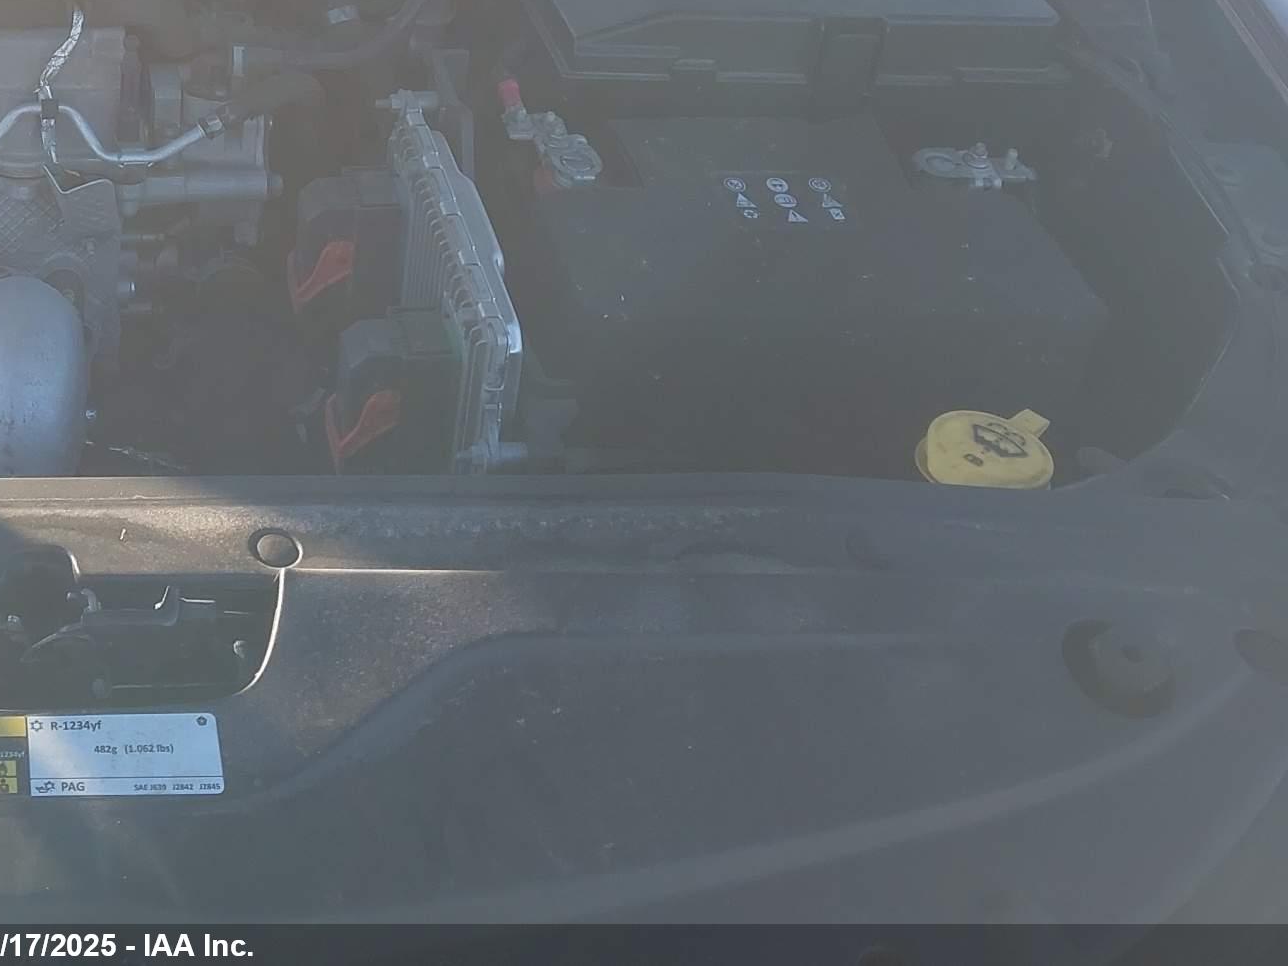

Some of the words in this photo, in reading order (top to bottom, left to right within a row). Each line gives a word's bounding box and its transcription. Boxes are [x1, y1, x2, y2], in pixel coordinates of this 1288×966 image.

[50, 719, 102, 732] R-1234yf
[94, 744, 118, 755] 482g
[61, 782, 85, 793] PAG
